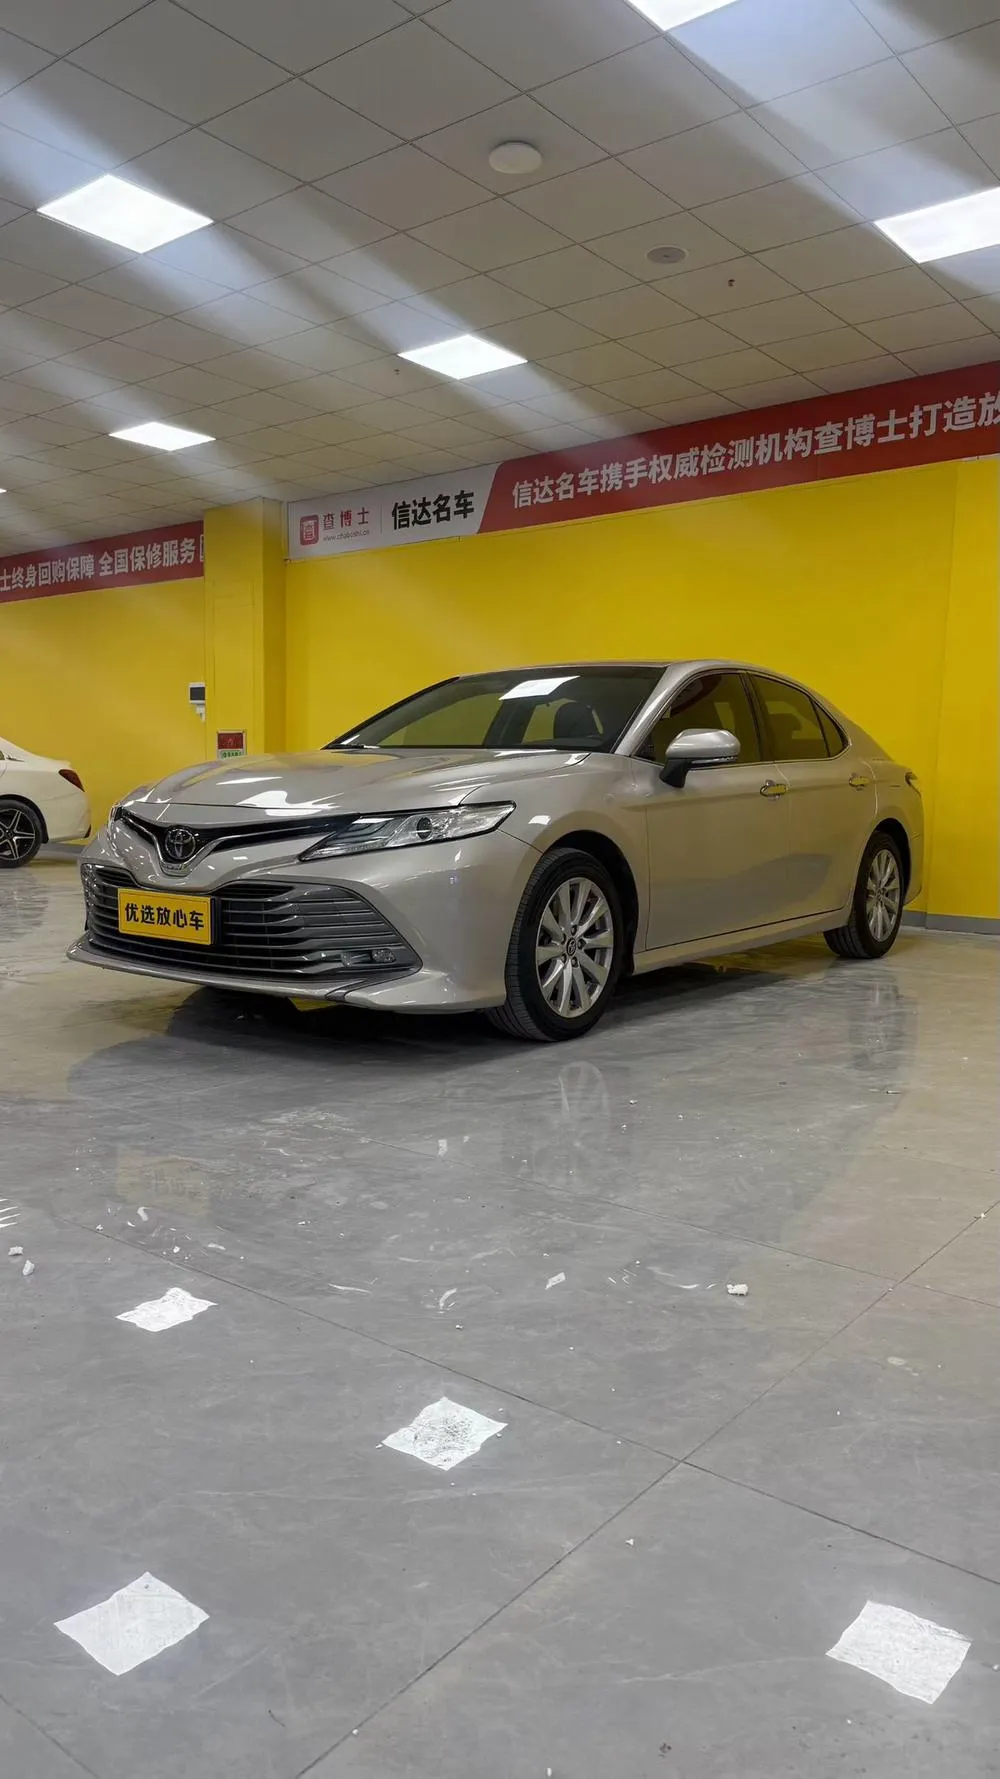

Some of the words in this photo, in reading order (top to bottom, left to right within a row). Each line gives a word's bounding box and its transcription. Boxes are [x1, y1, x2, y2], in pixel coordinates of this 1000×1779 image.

[512, 390, 1000, 509] 信达名车携手权威检测机构查博士打造放
[323, 507, 369, 530] 查博士
[391, 489, 474, 530] 信达名车
[0, 554, 95, 592] 士终身回购保障
[98, 537, 196, 577] 全国保修服务
[124, 902, 204, 931] 优选放心车
